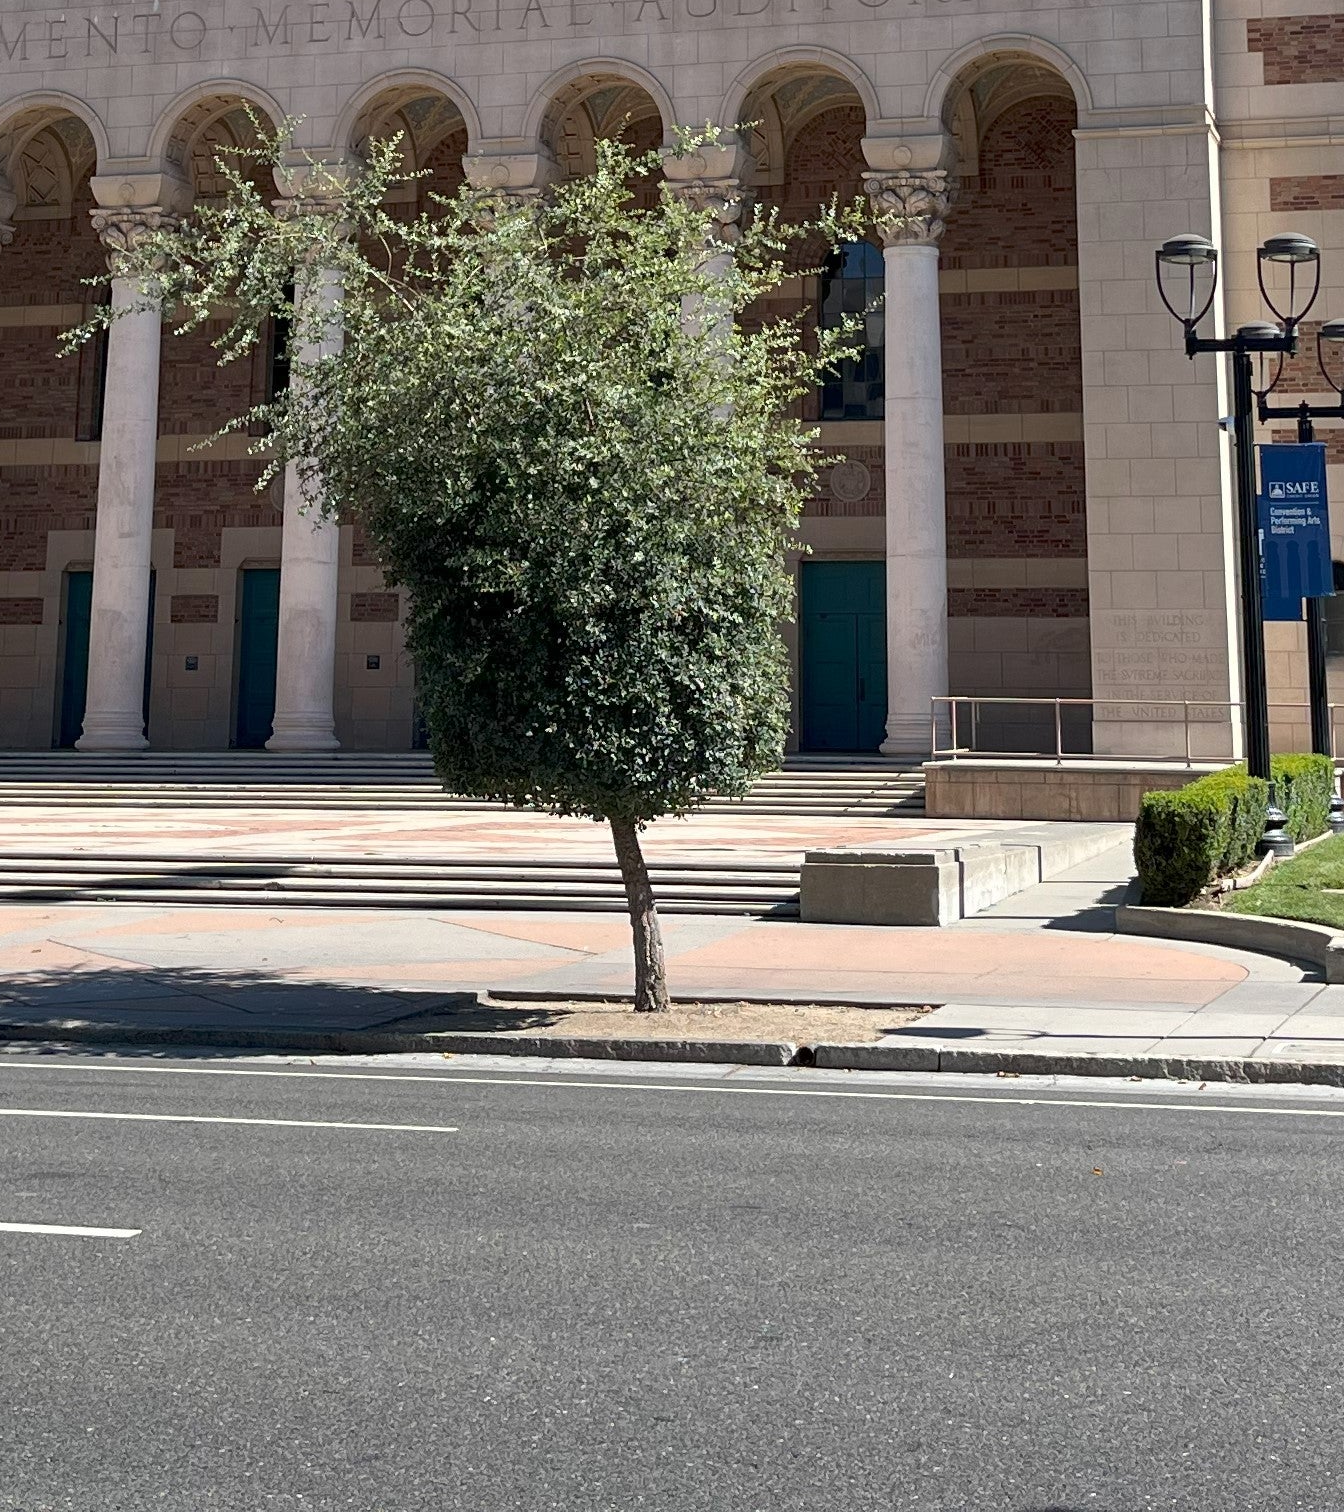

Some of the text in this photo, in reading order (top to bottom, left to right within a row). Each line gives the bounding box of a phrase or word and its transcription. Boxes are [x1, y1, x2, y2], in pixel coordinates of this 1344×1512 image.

[1286, 482, 1319, 493] SAFE
[1270, 507, 1312, 515] Convention &
[1271, 516, 1320, 527] Performing Arts
[1136, 631, 1202, 643] DEDICATED
[1100, 706, 1122, 718] THE
